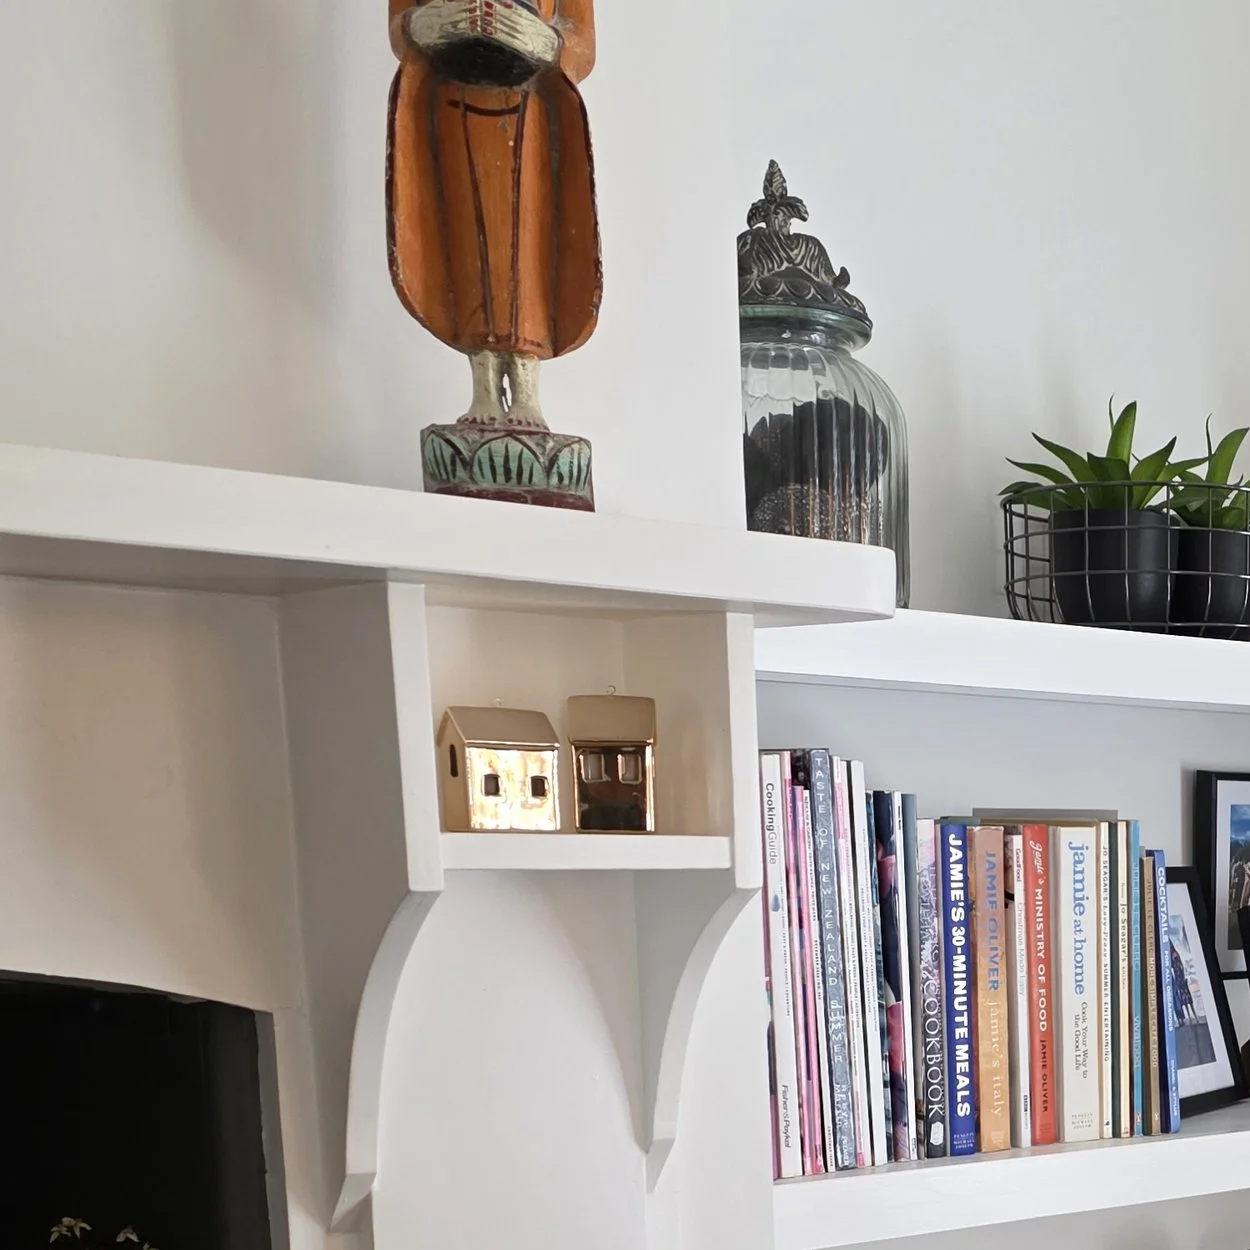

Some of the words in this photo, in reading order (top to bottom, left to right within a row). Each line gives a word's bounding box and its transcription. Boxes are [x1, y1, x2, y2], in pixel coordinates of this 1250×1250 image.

[815, 757, 827, 814] TASTE
[818, 827, 829, 850] OF
[1103, 845, 1108, 856] JO
[821, 862, 832, 896] NEW
[948, 833, 965, 922] JAMIE'S
[985, 850, 997, 911] JAMIE
[1068, 841, 1089, 917] jamie
[1017, 902, 1025, 946] Christmas
[1035, 888, 1045, 959] MINISTRY
[1073, 919, 1084, 935] at
[825, 908, 838, 987] ZEALAND
[987, 918, 999, 992] OLIVER
[1018, 948, 1026, 973] Made
[1074, 937, 1087, 995] home
[1158, 866, 1169, 944] COCKTAILS
[1166, 986, 1174, 1032] OCCASIONS
[951, 926, 969, 1040] 30-MINUTE
[1037, 963, 1046, 984] OF
[830, 999, 843, 1064] SUMMER
[1038, 989, 1048, 1032] FOOD
[923, 980, 943, 1118] COOKBOOK
[984, 999, 1002, 1068] jamie's
[1040, 1039, 1048, 1070] JAMIE
[1074, 1030, 1082, 1052] Good
[1081, 1026, 1089, 1048] Your
[956, 1044, 971, 1117] MEALS
[1074, 1054, 1082, 1071] Life
[1081, 1050, 1089, 1069] Way
[1082, 1070, 1088, 1079] to
[990, 1074, 1004, 1117] italy
